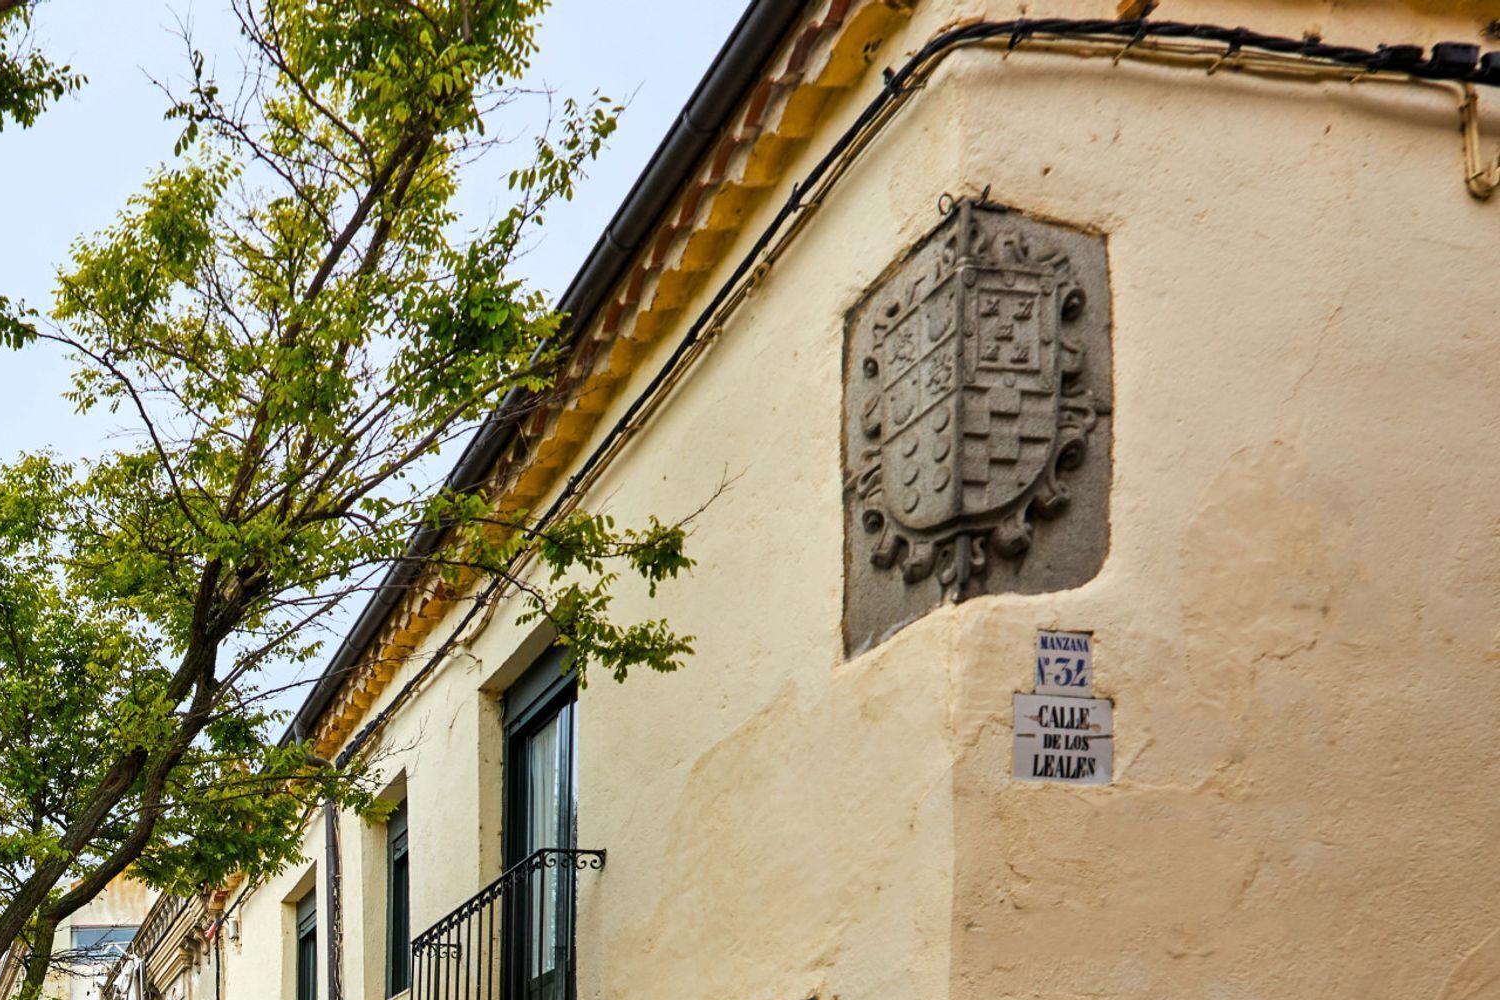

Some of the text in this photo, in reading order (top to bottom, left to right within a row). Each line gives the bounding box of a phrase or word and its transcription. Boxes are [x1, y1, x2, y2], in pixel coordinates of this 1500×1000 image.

[1040, 635, 1089, 653] MANZANA
[1054, 657, 1088, 688] 34
[1038, 704, 1091, 731] CALLE
[1043, 733, 1090, 751] DE LOS
[1032, 753, 1097, 780] LEALES
